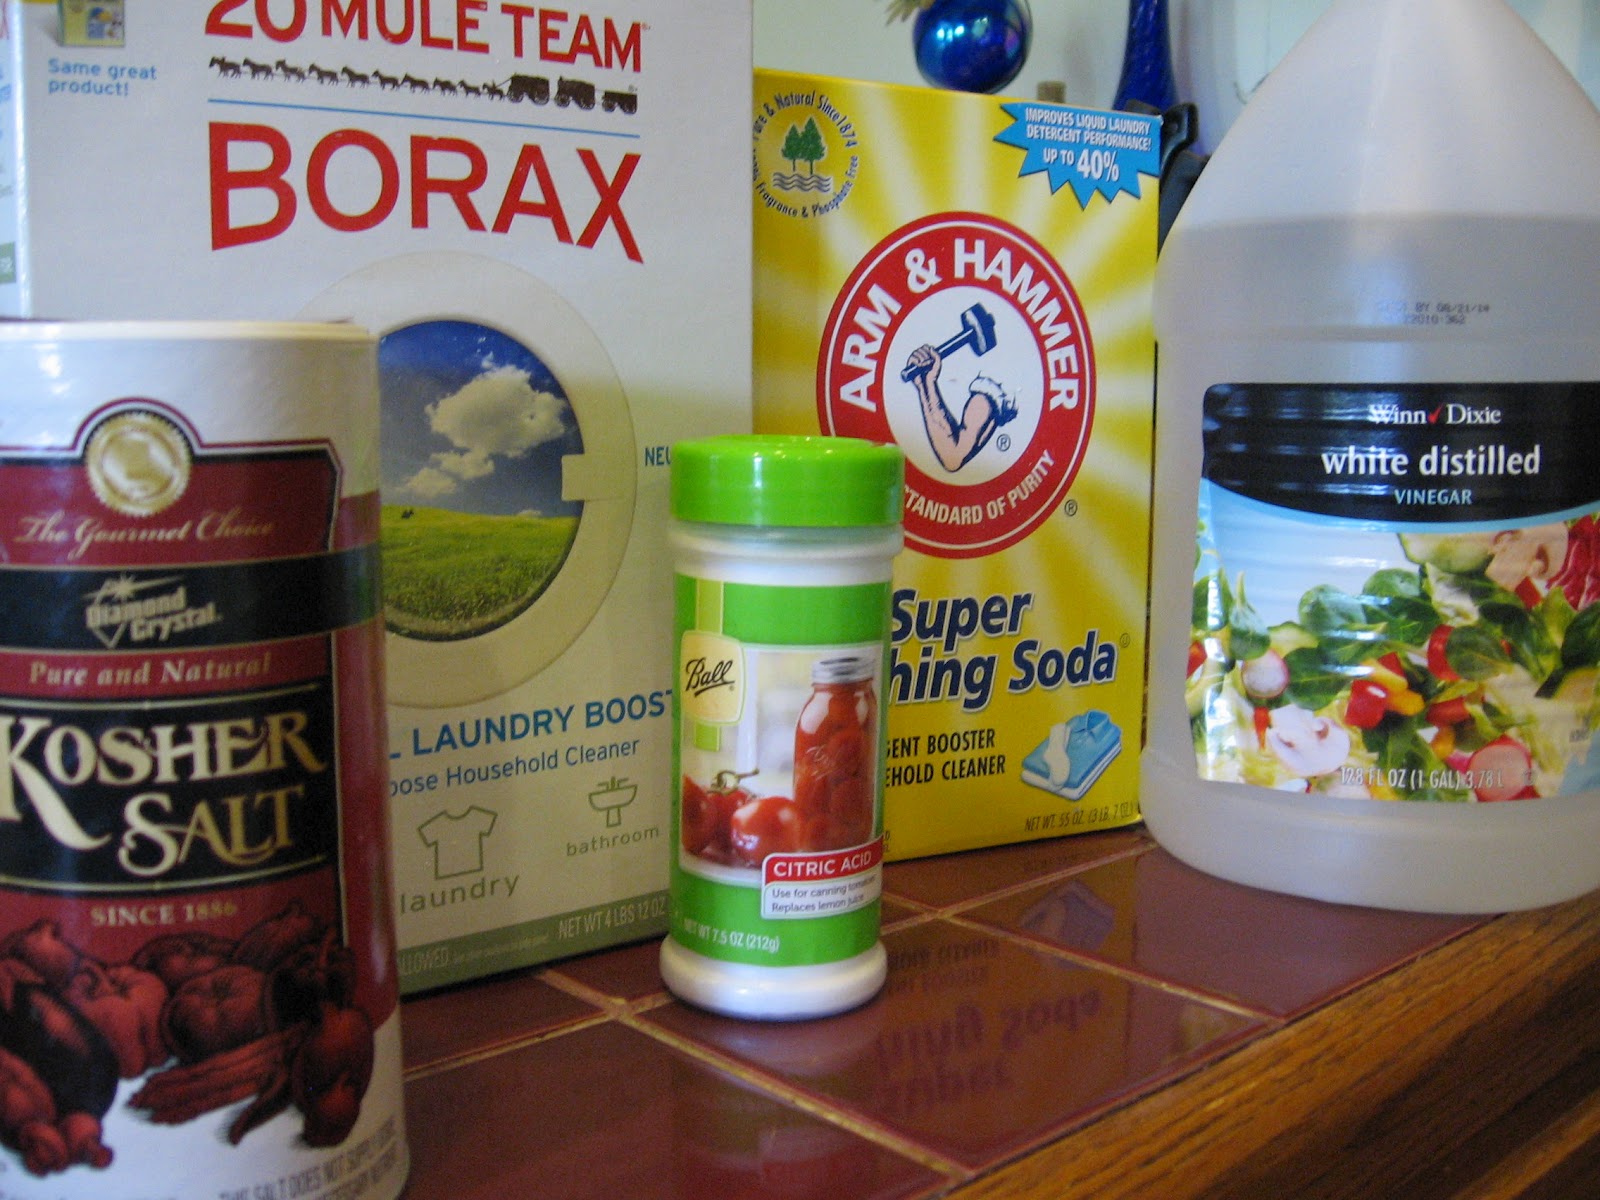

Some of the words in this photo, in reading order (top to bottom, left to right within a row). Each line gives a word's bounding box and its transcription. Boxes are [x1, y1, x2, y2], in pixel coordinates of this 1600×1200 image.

[320, 0, 490, 54] MULE
[501, 4, 641, 73] TEAM
[48, 58, 101, 76] Same
[108, 65, 157, 80] great
[48, 80, 128, 97] product!
[775, 90, 816, 110] Natural
[817, 94, 841, 122] Since
[836, 115, 858, 148] 1874
[1025, 107, 1074, 126] IMPROVES
[1076, 113, 1106, 130] LIQUID
[1108, 118, 1151, 135] LAUNDRY
[1027, 124, 1080, 144] DETERGENT
[1083, 130, 1152, 152] PERFORMANCE!
[1043, 147, 1058, 163] UP
[1060, 150, 1075, 166] TO
[1076, 148, 1120, 183] 40%
[208, 121, 643, 265] BORAX
[756, 182, 798, 217] Fragrance
[840, 283, 902, 413] ARM
[904, 248, 943, 294] &
[954, 238, 1080, 411] HAMMER
[1369, 404, 1427, 425] Winn
[1446, 404, 1502, 425] Dixie
[1321, 445, 1409, 475] white
[1419, 445, 1541, 475] distilled
[903, 483, 983, 525] TANDARD
[986, 494, 1006, 521] OF
[1008, 449, 1054, 508] PURITY
[1394, 489, 1473, 506] VINEGAR
[14, 510, 69, 543] The
[68, 518, 193, 561] Gourmet
[196, 506, 275, 543] Choice
[890, 588, 1034, 655] Super
[30, 661, 89, 686] Pure
[97, 660, 151, 685] and
[161, 652, 272, 685] Natural
[685, 657, 736, 697] Ball
[1007, 629, 1119, 694] Soda
[413, 705, 575, 757] LAUNDRY
[927, 728, 996, 754] BOOSTER
[446, 752, 558, 787] Household
[565, 739, 640, 767] Cleaner
[941, 755, 1006, 781] CLEANER
[1340, 766, 1364, 785] 128
[1368, 767, 1383, 786] FL
[1388, 770, 1406, 788] OZ
[1410, 770, 1424, 790] (1
[1429, 769, 1461, 789] GAL)
[1465, 768, 1494, 789] 3.78
[0, 711, 328, 850] KOSHER
[118, 785, 304, 876] SALT
[1024, 815, 1041, 832] NET
[1060, 811, 1072, 827] 55
[566, 825, 660, 857] bathroom
[773, 861, 836, 877] CITRIC
[841, 851, 872, 871] ACID
[399, 874, 520, 914] laundry
[772, 889, 791, 898] Use
[794, 888, 808, 898] for
[810, 884, 847, 897] canning
[772, 902, 816, 914] Replaces
[819, 899, 846, 910] lemon
[91, 904, 175, 927] SINCE
[559, 916, 581, 938] NET
[584, 911, 602, 934] WT
[605, 909, 613, 928] 4
[614, 903, 635, 926] LBS
[712, 928, 727, 946] 7.5
[729, 931, 744, 948] OZ
[745, 933, 781, 954] (212g)
